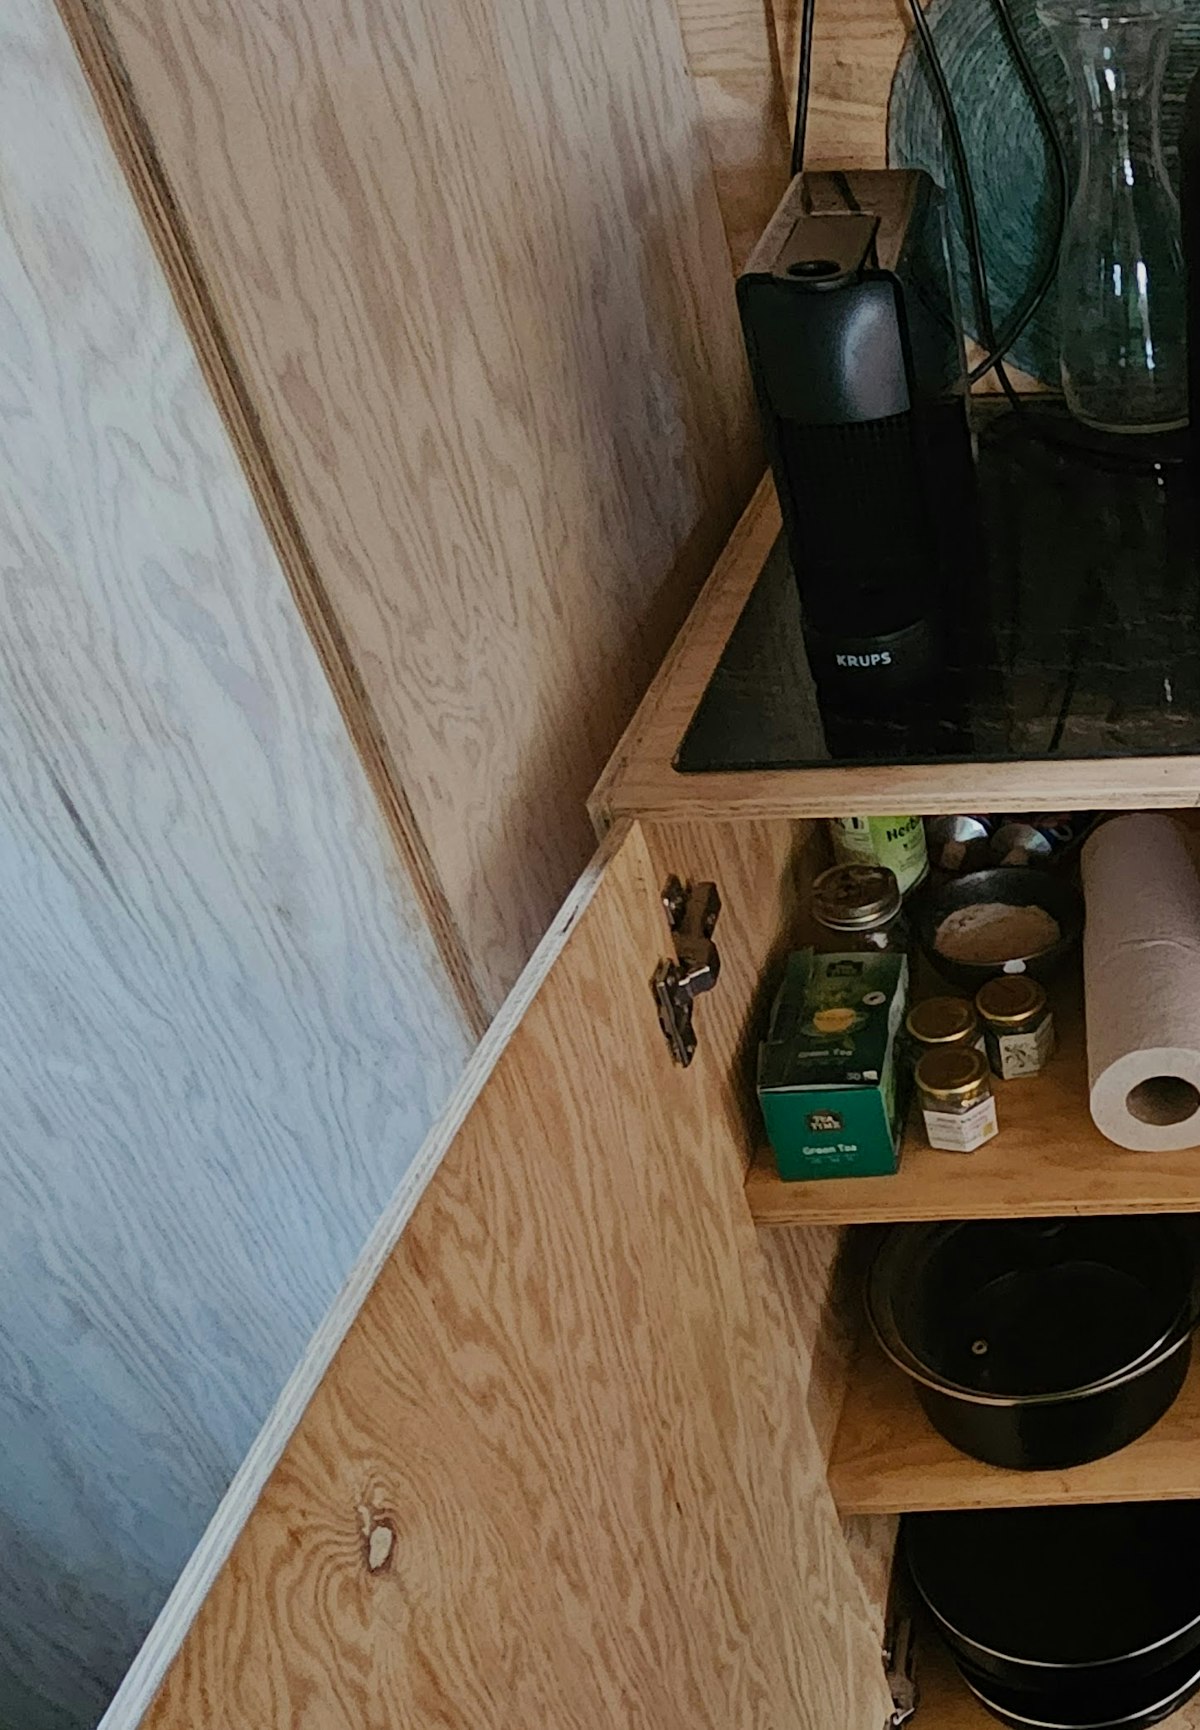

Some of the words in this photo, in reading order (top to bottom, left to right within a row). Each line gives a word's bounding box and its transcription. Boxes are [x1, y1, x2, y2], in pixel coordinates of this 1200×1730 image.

[835, 651, 893, 667] KRUPS
[833, 1048, 854, 1057] Tea
[811, 1115, 835, 1123] TEA
[809, 1120, 842, 1131] TIME
[802, 1146, 837, 1156] Green
[837, 1144, 858, 1153] Tea
